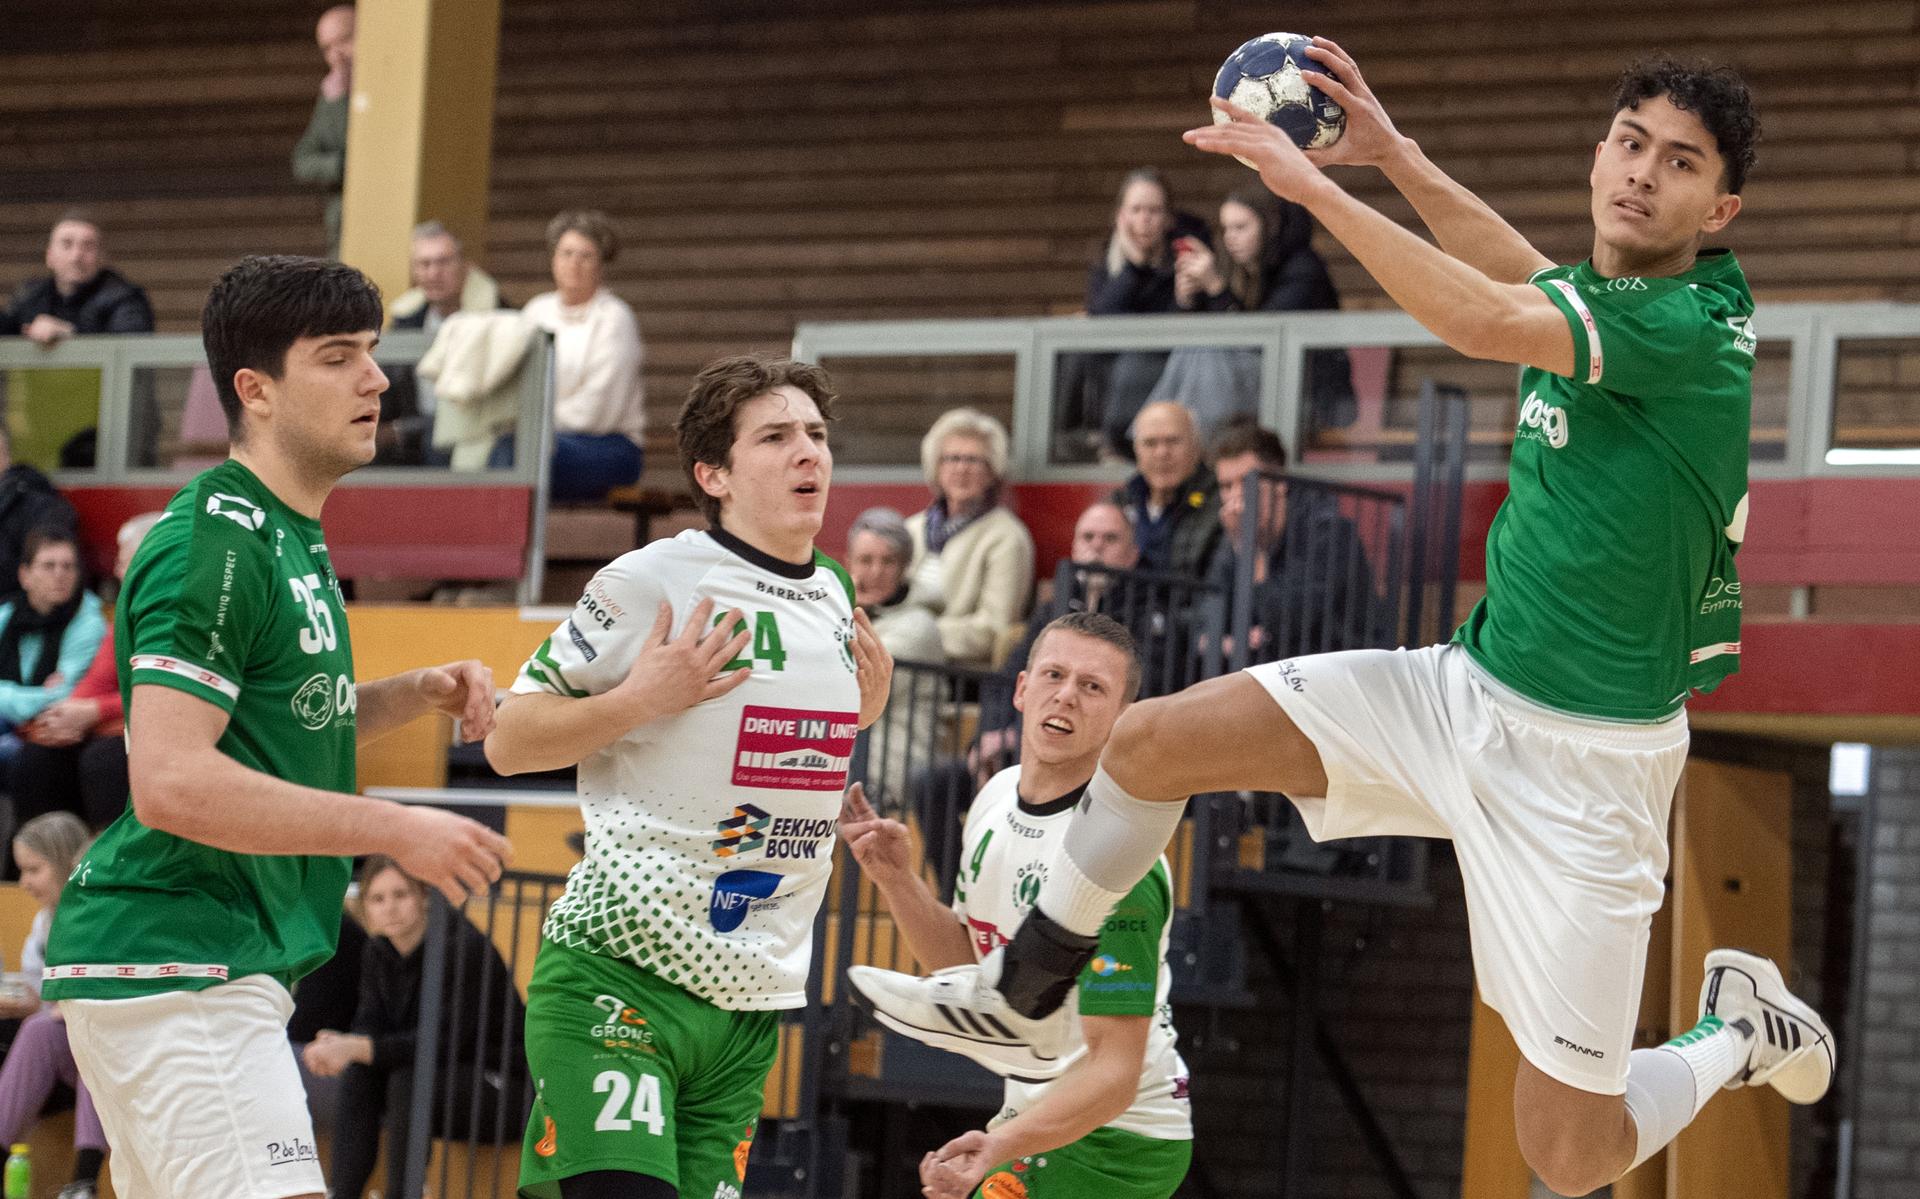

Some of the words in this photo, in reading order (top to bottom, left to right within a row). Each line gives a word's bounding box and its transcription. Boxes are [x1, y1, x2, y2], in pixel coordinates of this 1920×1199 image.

[221, 550, 237, 592] INSPECT
[288, 572, 338, 655] 35
[743, 716, 797, 736] DRIVE
[799, 719, 827, 740] IN
[765, 839, 820, 859] BOUW
[1553, 1035, 1605, 1059] STANNO
[592, 1070, 666, 1137] 24
